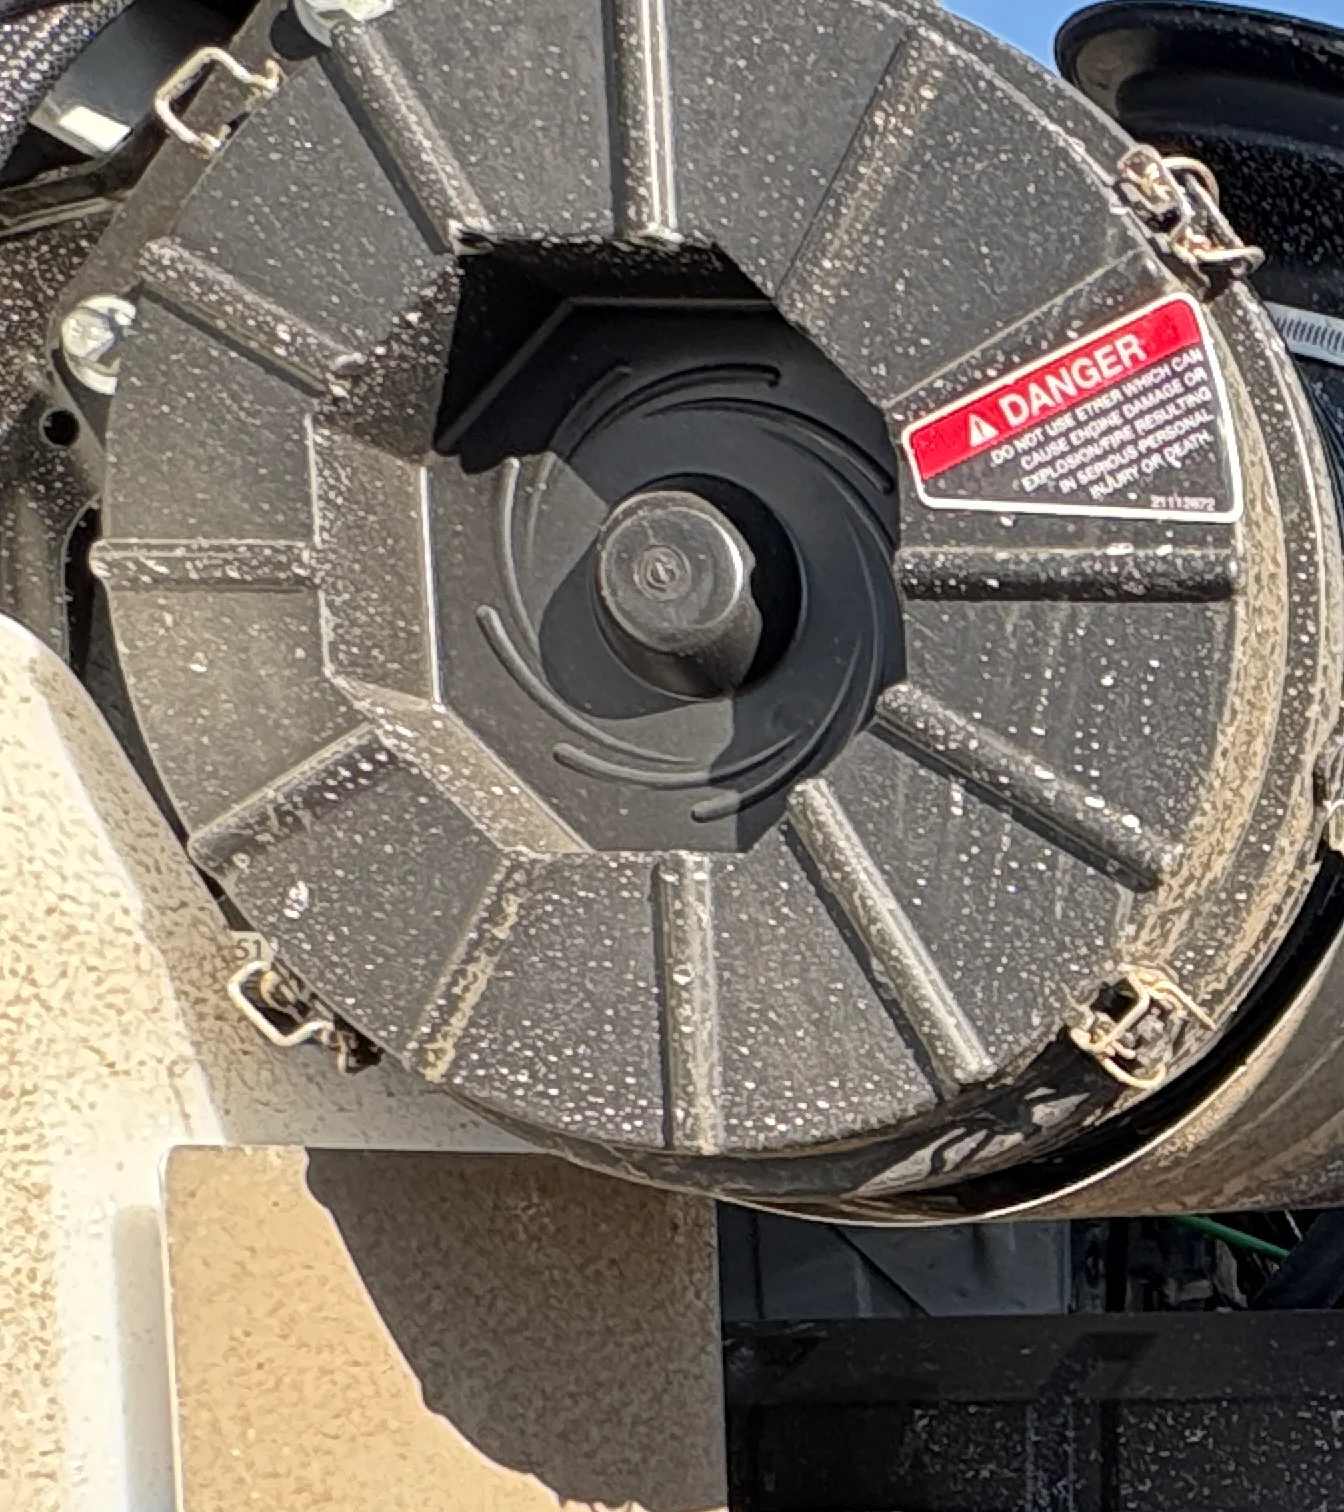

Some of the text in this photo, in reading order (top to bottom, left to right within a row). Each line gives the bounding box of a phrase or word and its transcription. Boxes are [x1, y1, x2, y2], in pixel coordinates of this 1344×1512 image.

[991, 348, 1204, 466] DO NOT USE ETHER WHICH CAN
[998, 334, 1148, 428] DANGER
[1020, 366, 1208, 471] CAUSE ENGINE DAMAGE OR
[1134, 386, 1213, 435] RESULTING
[1058, 408, 1214, 494] IN SERIOUS PERSONAL
[1089, 464, 1139, 498] INJURY
[1140, 452, 1165, 474] OR
